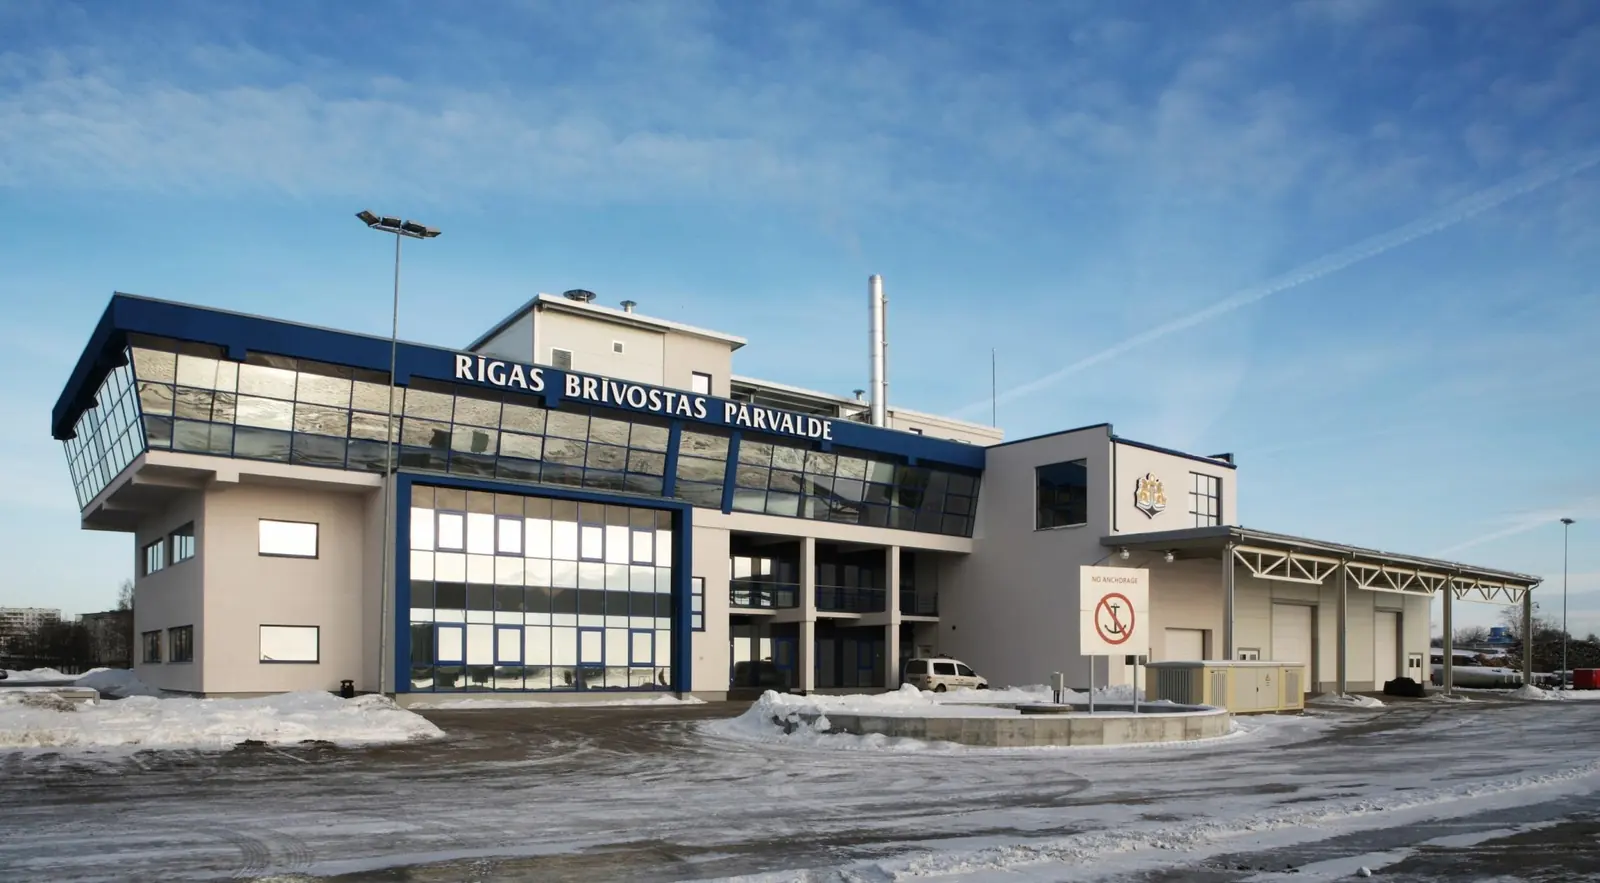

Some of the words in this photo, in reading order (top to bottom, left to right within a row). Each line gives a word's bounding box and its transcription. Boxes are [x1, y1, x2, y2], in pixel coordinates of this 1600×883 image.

[455, 354, 545, 392] RĪGAS
[565, 373, 707, 419] BRĪVOSTAS
[724, 402, 833, 441] PĀRVALDE
[1102, 576, 1138, 584] ANCHORAGE
